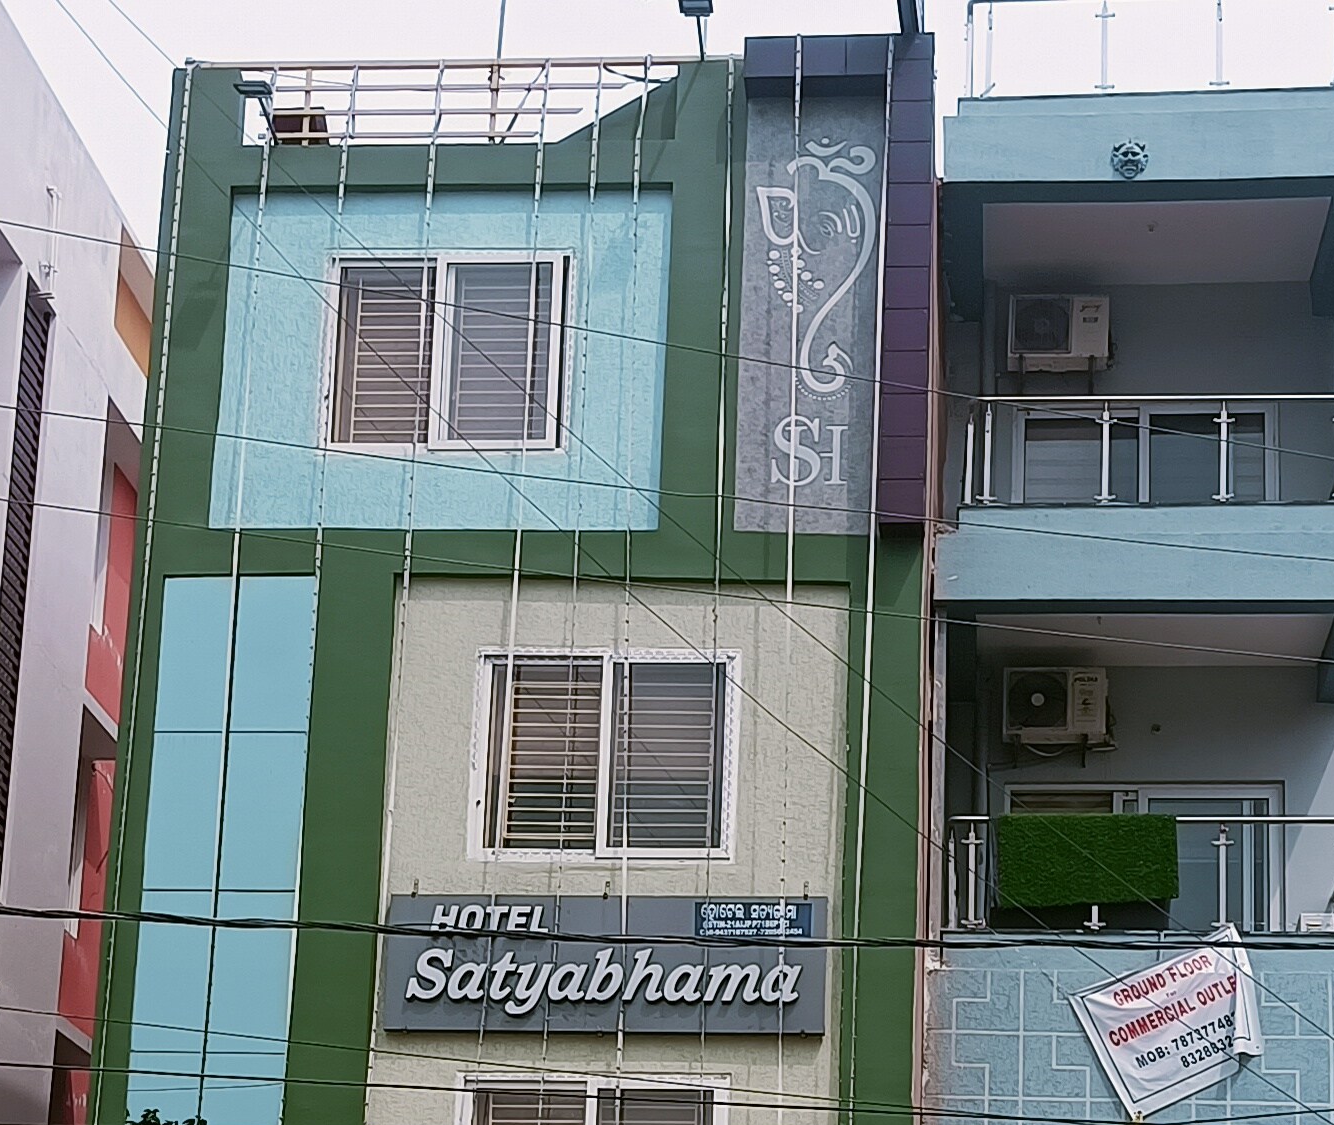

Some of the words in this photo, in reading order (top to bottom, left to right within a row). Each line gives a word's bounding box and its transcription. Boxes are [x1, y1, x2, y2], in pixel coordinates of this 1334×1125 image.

[430, 904, 549, 932] HOTEL
[406, 947, 802, 1015] Satyabhama
[1113, 972, 1167, 1006] GROUND
[1166, 955, 1213, 984] FLOOR
[1108, 997, 1196, 1047] COMMERCIAL
[1196, 972, 1237, 1006] OUTLE
[1135, 1046, 1171, 1068] MOB:
[1171, 1011, 1235, 1051] 78737748
[1180, 1035, 1234, 1068] 8328832
